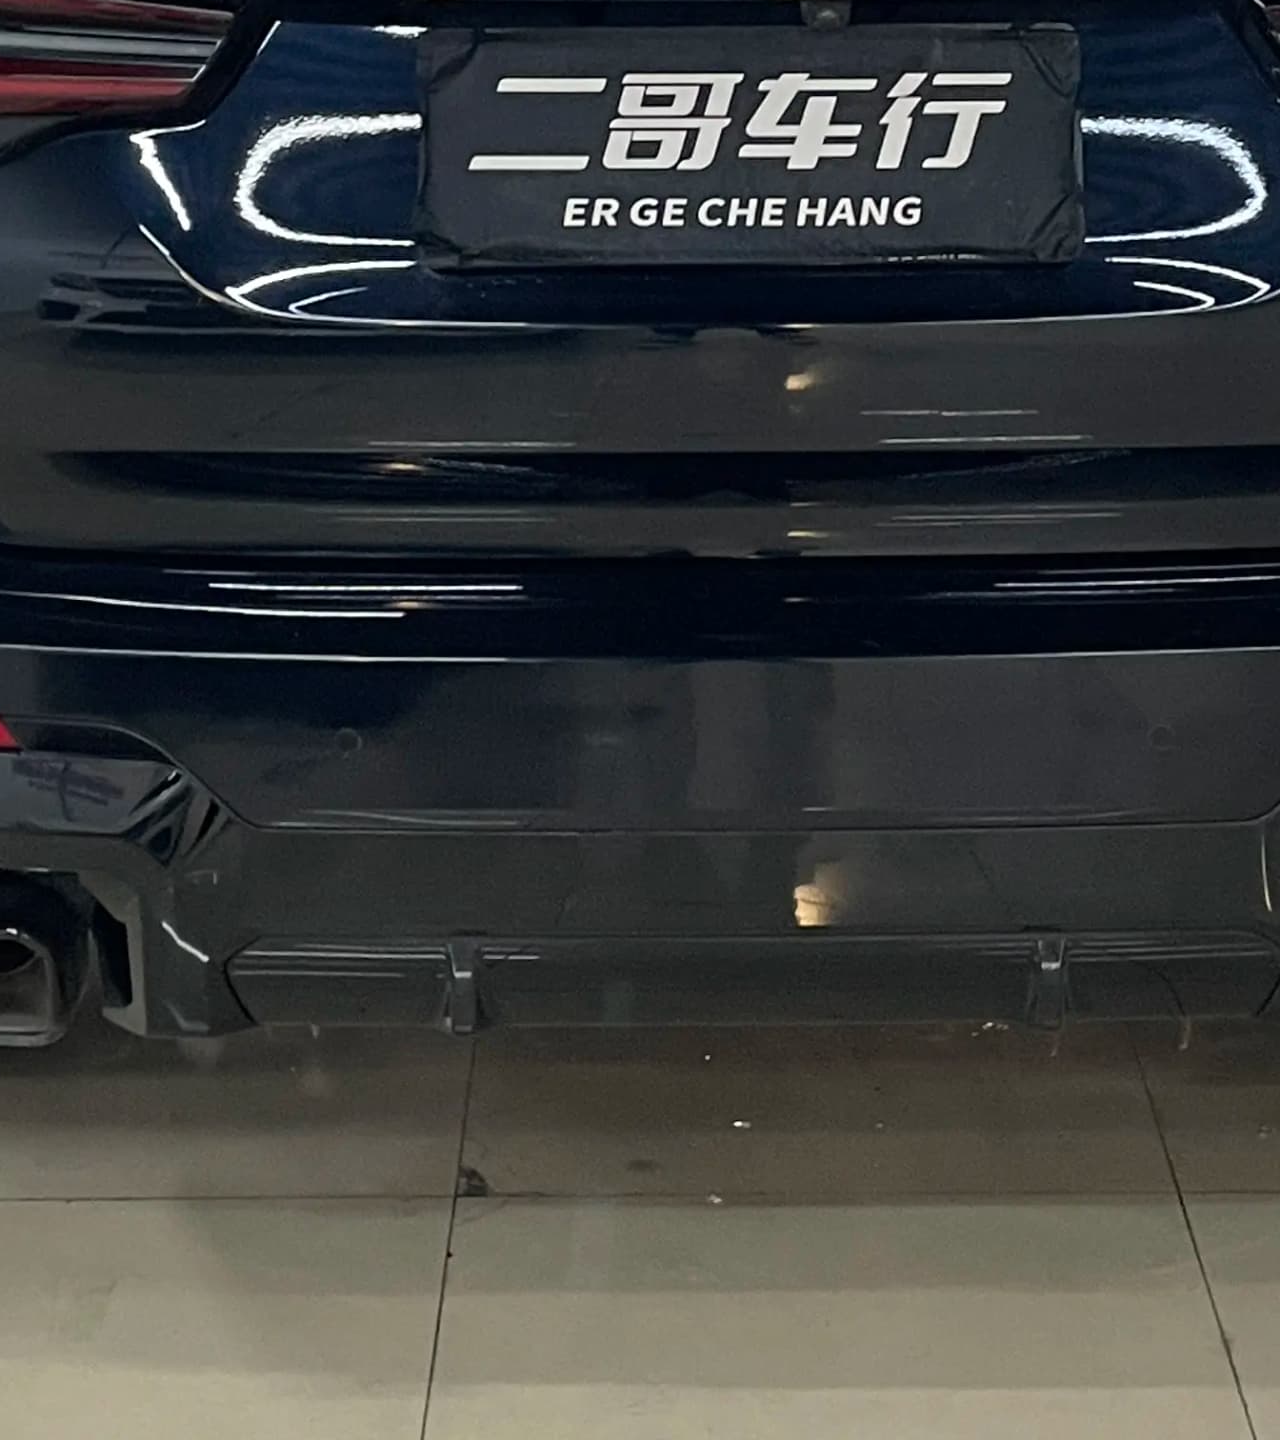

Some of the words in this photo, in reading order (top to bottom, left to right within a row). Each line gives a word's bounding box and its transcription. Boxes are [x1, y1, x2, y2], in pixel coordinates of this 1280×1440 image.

[467, 72, 1013, 171] 二哥车行
[562, 197, 619, 227] ER
[628, 197, 688, 228] GE
[696, 197, 787, 228] CHE
[795, 196, 923, 227] HANG
